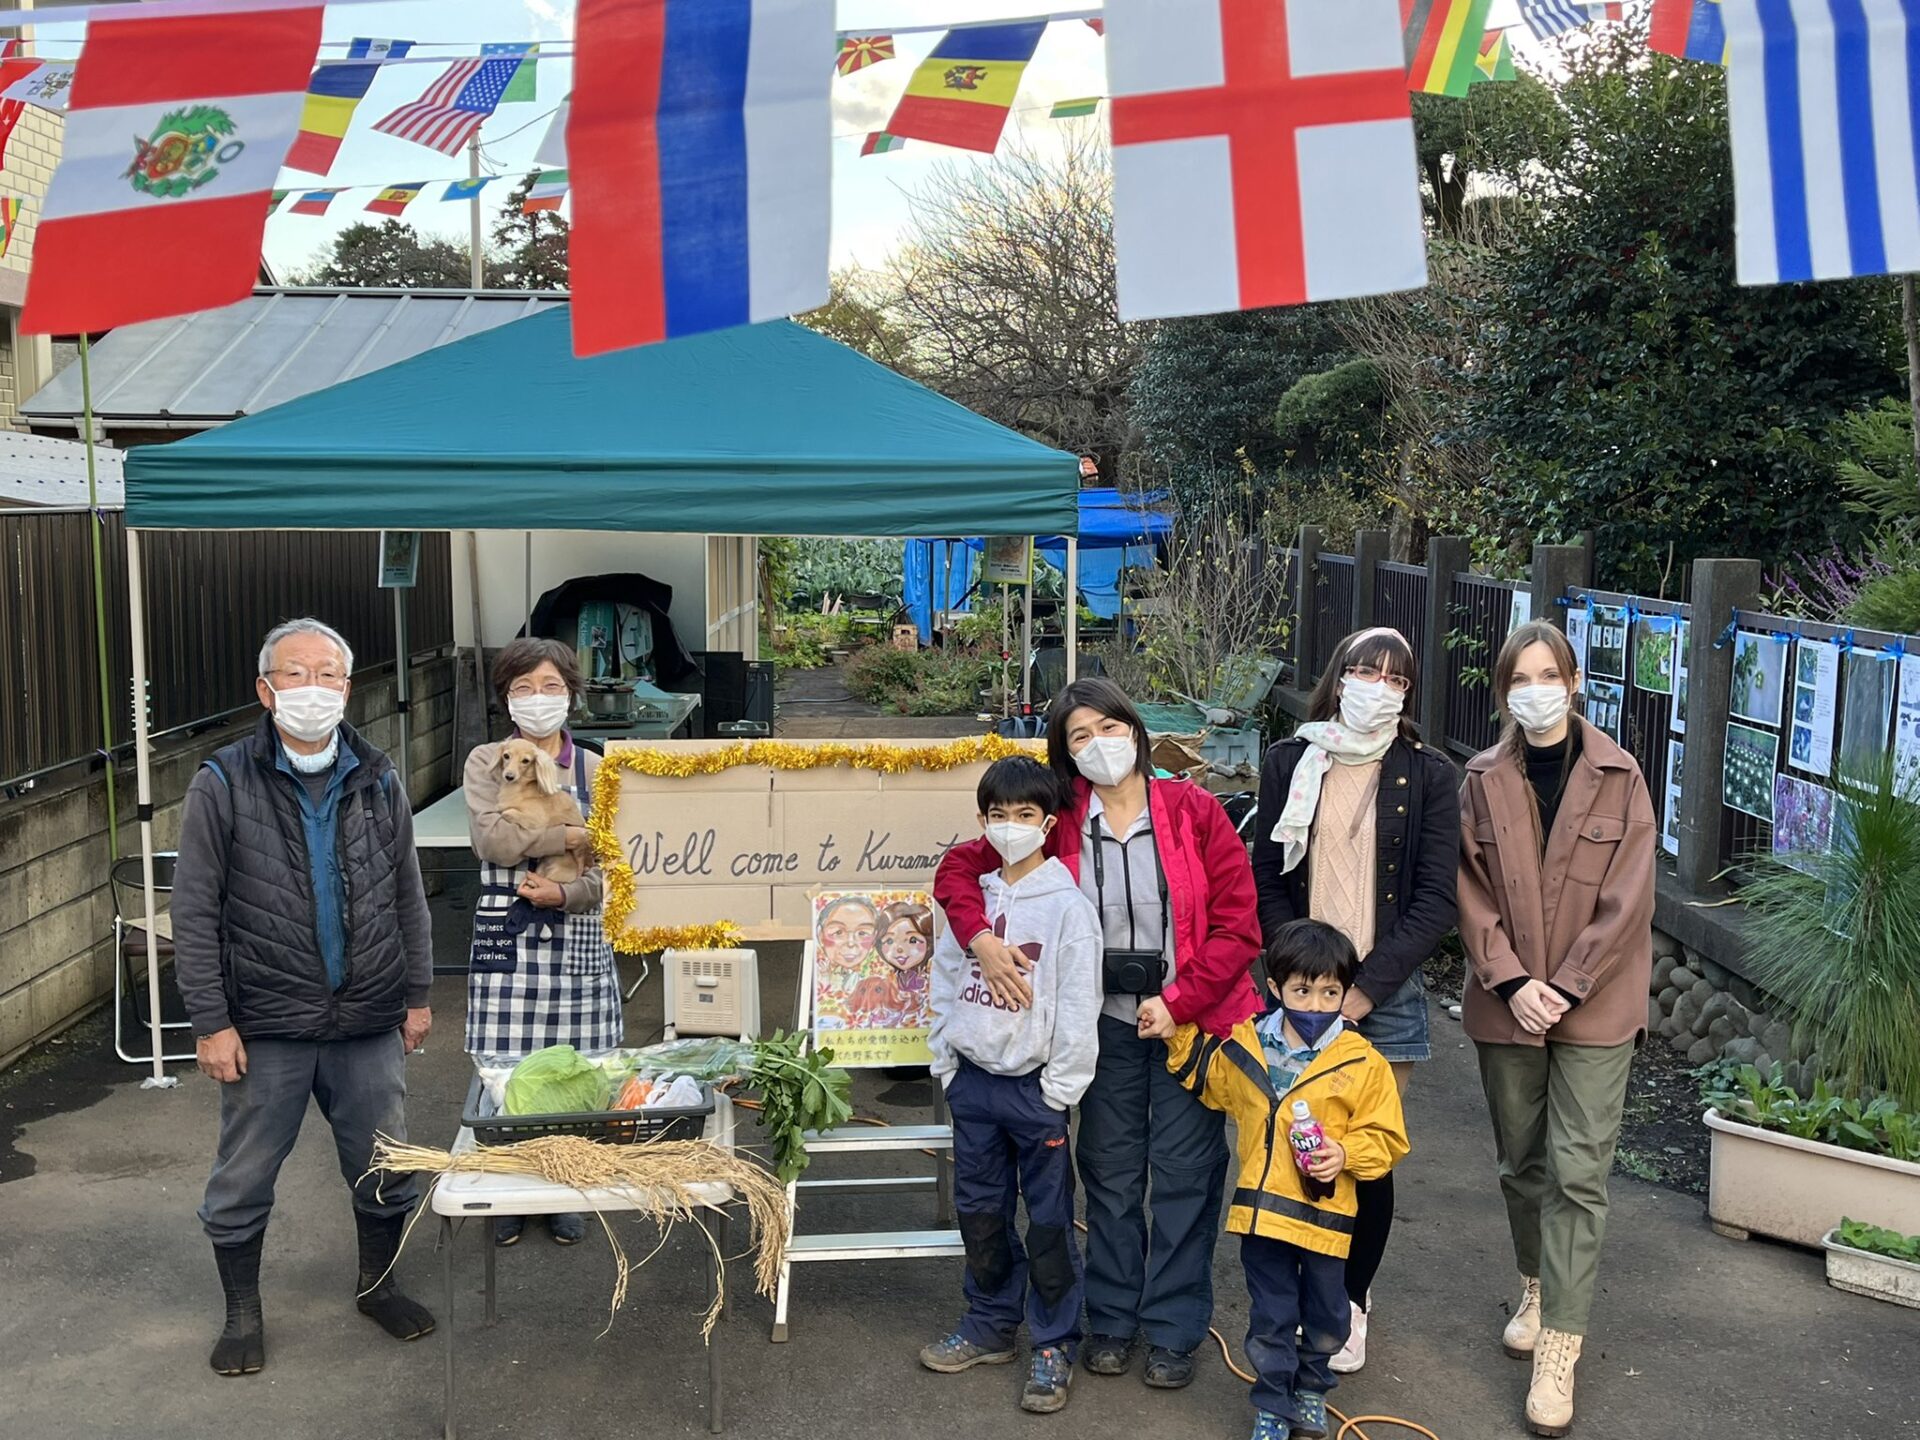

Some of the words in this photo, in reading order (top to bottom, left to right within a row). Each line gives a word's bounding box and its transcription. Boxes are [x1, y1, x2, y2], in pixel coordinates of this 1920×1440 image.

[628, 829, 716, 875] Well
[731, 852, 798, 876] come
[817, 834, 841, 871] to
[496, 939, 512, 947] upon
